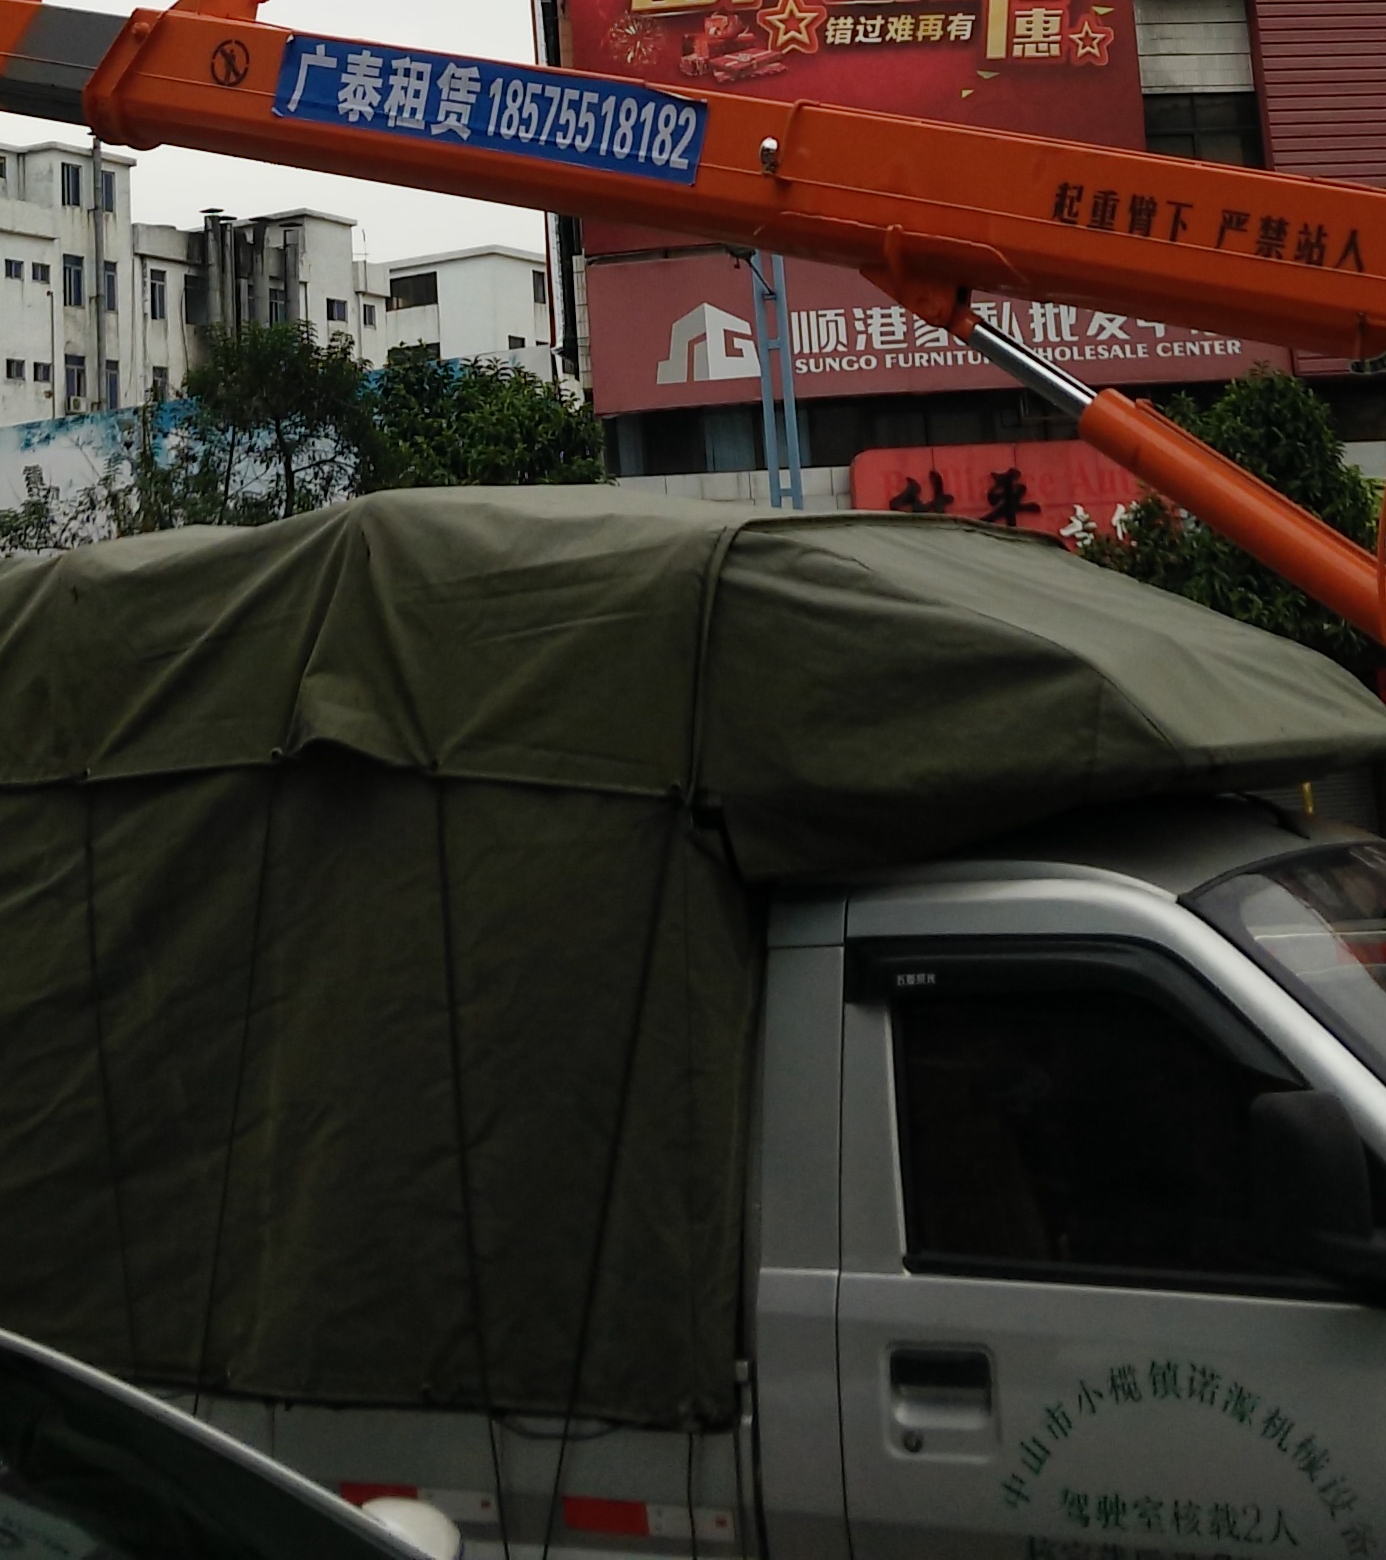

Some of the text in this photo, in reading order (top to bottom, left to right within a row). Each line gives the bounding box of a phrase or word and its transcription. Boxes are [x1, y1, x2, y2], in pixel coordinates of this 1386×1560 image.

[824, 12, 977, 47] 错过难再有
[287, 44, 700, 172] 广泰租赁 18575518182
[1051, 181, 1366, 273] 起重臂下 严禁站人
[795, 339, 1243, 374] SUNGO FURNITU HOLESALE CENTER
[1059, 1488, 1301, 1548] 驾驶室核载2人
